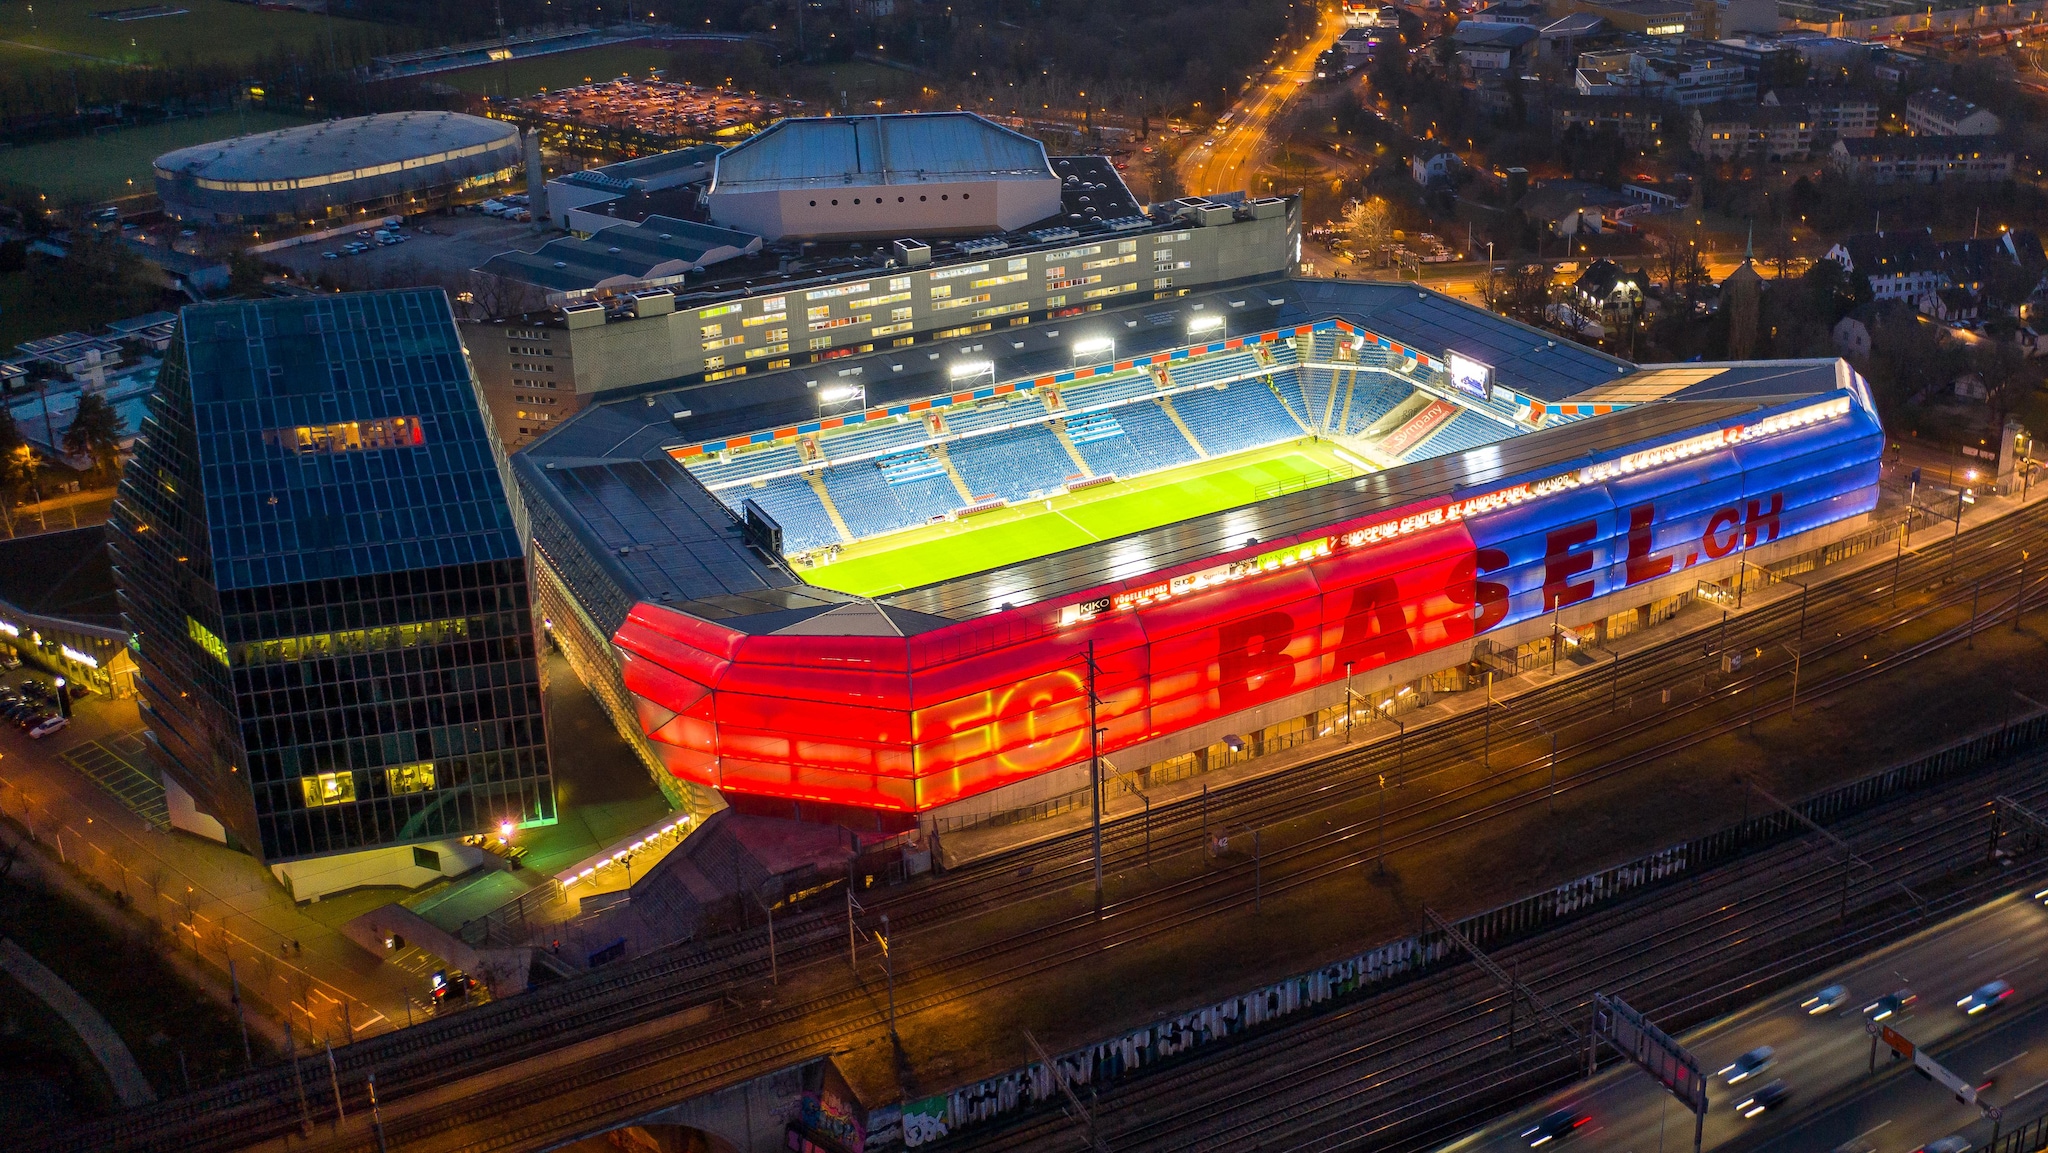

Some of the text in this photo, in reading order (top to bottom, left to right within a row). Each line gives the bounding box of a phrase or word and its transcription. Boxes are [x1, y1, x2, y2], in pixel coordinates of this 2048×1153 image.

[1394, 404, 1443, 446] sympany
[1538, 474, 1569, 491] MANOR
[1341, 521, 1398, 545] SHOPPING
[1400, 509, 1442, 530] CENTER
[1464, 486, 1527, 514] JAKOB-PARK
[1260, 549, 1295, 565] MANOR
[1114, 584, 1168, 605] VÖGELE SHOES
[1080, 598, 1110, 614] KIKO
